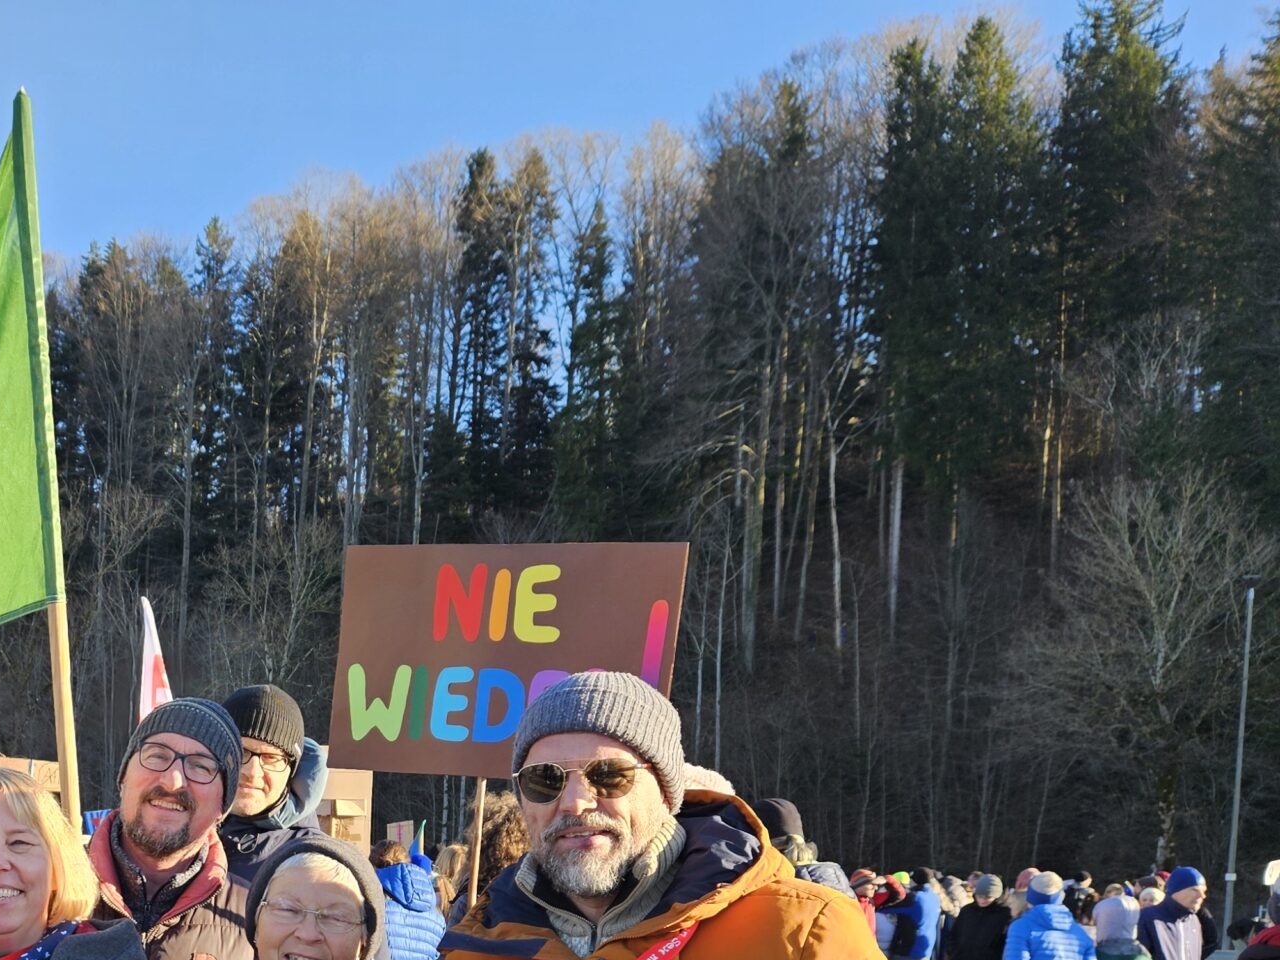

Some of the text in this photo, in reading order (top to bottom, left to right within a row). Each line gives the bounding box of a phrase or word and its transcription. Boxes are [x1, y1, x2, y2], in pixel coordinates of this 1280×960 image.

[432, 562, 562, 644] NIE
[348, 599, 669, 743] WIED!
[658, 937, 681, 956] Sex
